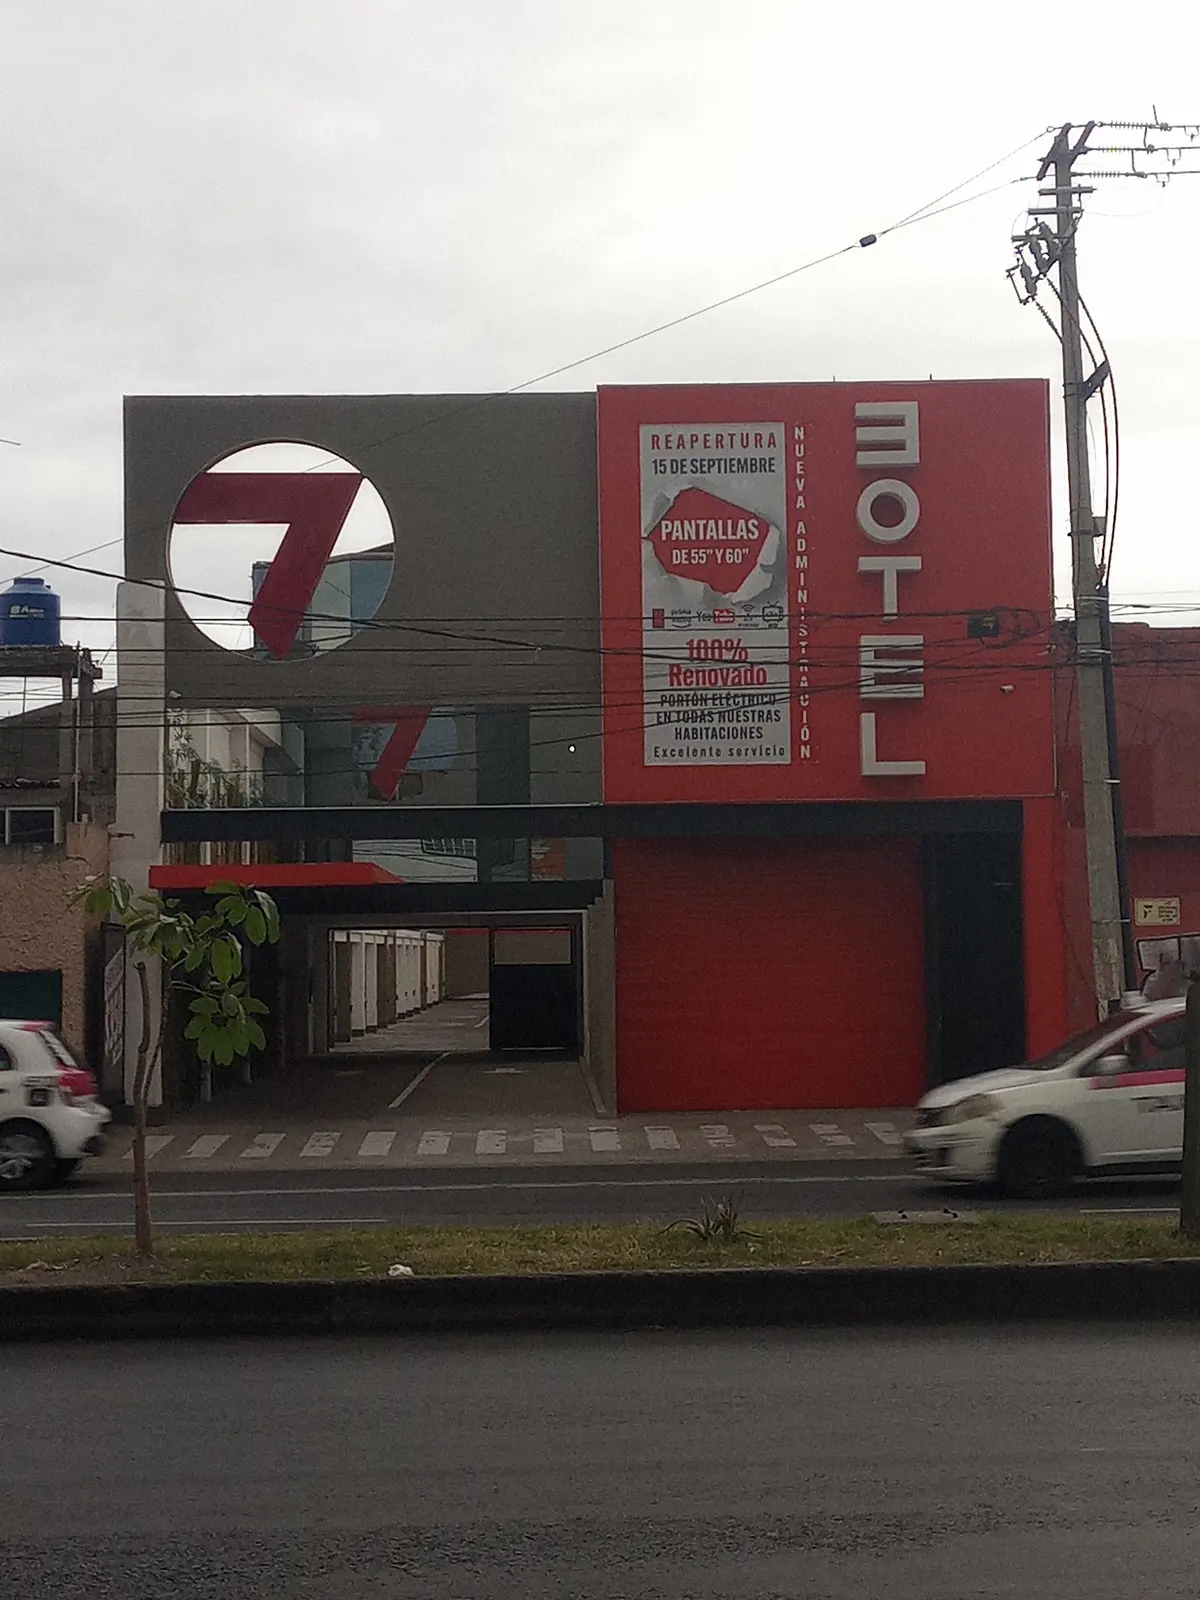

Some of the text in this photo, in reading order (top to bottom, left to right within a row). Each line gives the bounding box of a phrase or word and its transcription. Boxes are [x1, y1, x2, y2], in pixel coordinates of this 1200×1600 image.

[651, 432, 778, 450] REAPERTURA
[652, 456, 776, 475] 15 DE SEPTIEMBRE
[661, 518, 760, 541] PANTALLAS
[173, 471, 364, 661] 7
[672, 549, 689, 565] DE
[715, 549, 724, 564] Y
[794, 426, 811, 759] NUEVA ADMINISTRACIÓN
[686, 638, 749, 663] 100%
[668, 663, 768, 687] Renovado
[660, 690, 777, 707] PORTÓN ELÉCTRICO
[656, 709, 781, 724] EN TODAS NUESTRAS
[674, 726, 764, 740] HABITACIONES
[653, 744, 786, 758] Excelente servicio
